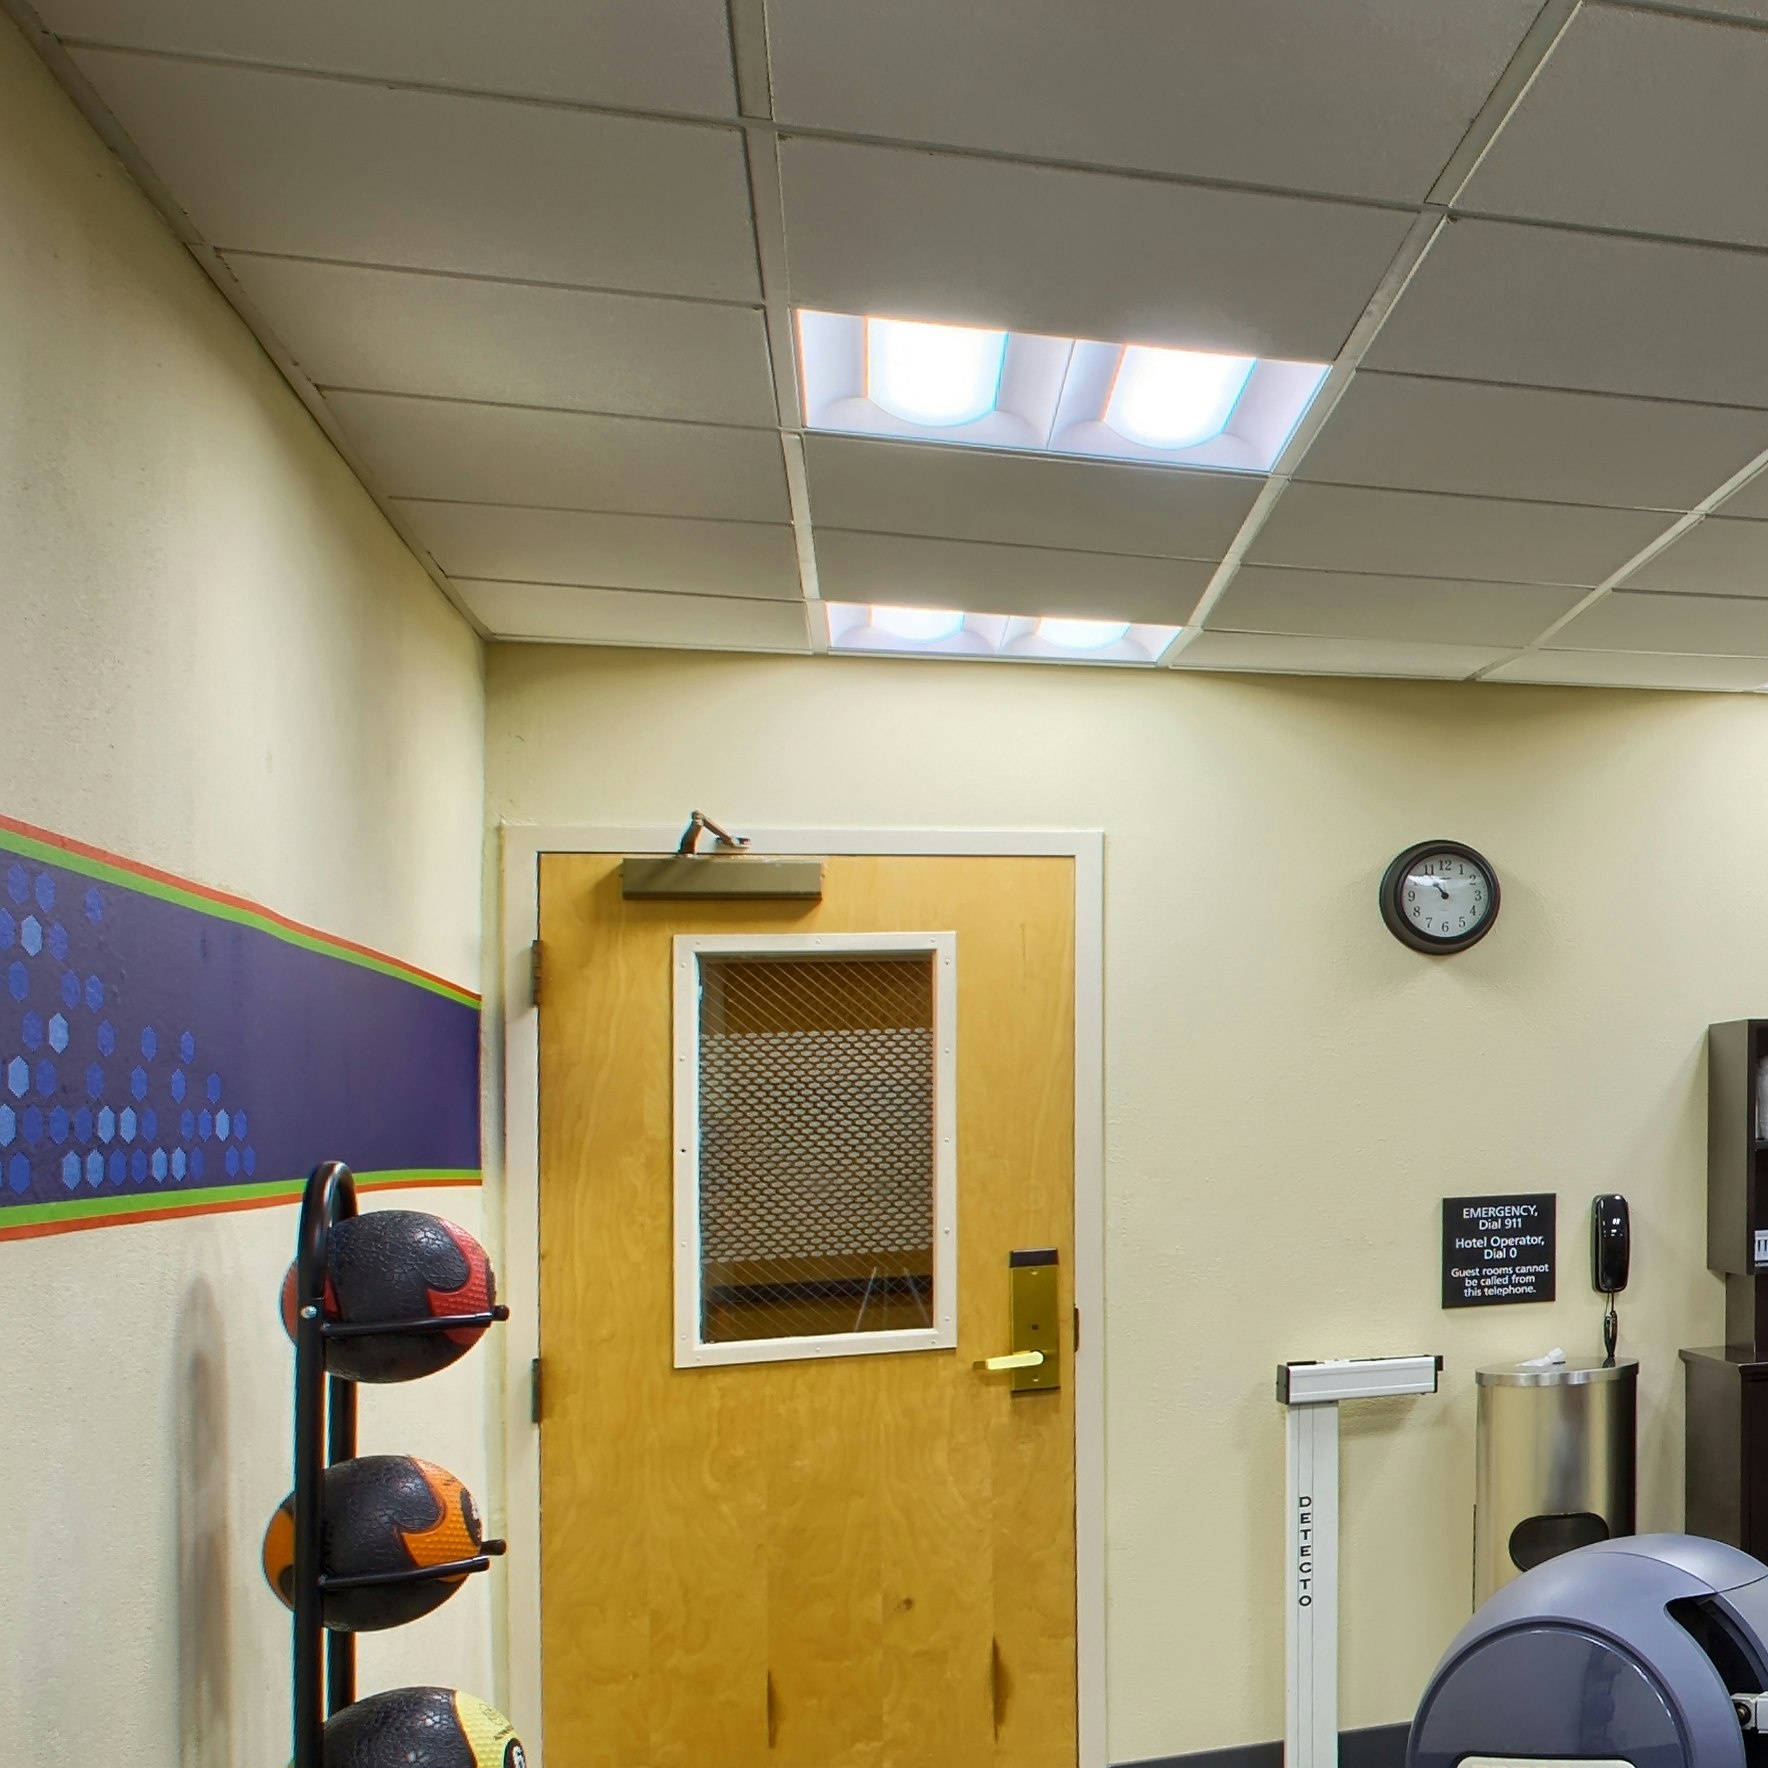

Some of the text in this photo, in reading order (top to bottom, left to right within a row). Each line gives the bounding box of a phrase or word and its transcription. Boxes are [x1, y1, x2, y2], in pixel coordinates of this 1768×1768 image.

[1424, 864, 1434, 875] 11
[1439, 860, 1452, 871] 12
[1459, 864, 1464, 875] 1
[1469, 874, 1477, 885] 2
[1408, 891, 1416, 902] 9
[1474, 890, 1482, 901] 3
[1413, 906, 1421, 917] 8
[1469, 905, 1476, 916] 4
[1426, 917, 1433, 928] 7
[1441, 921, 1449, 932] 6
[1459, 917, 1466, 928] 5
[1463, 1205, 1538, 1219] EMERGENCY,
[1479, 1218, 1522, 1230] Dial 911
[1455, 1235, 1545, 1248] Hotel Operator,
[1484, 1247, 1517, 1259] Dial 0
[1451, 1264, 1549, 1278] Guest rooms cannot
[1465, 1274, 1535, 1287] be called from
[1463, 1285, 1537, 1298] this telephone.
[1299, 1496, 1312, 1607] DETECTO
